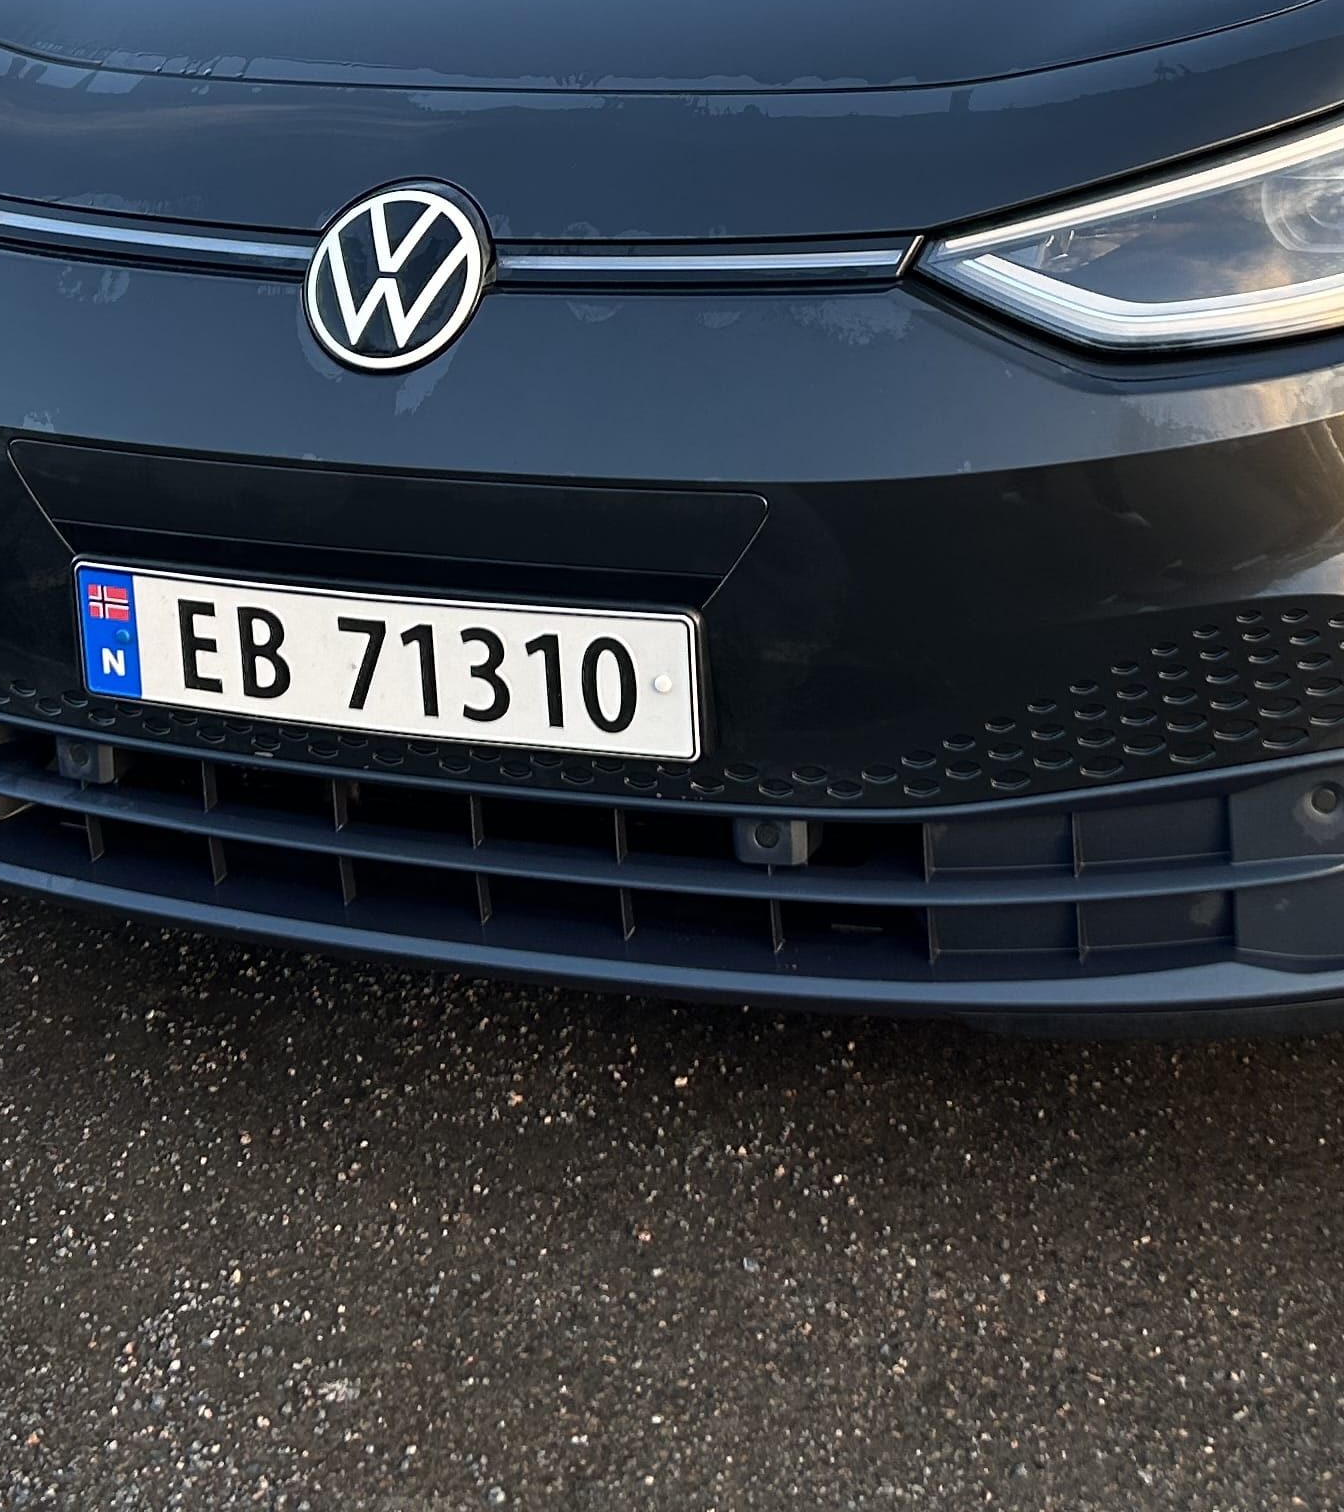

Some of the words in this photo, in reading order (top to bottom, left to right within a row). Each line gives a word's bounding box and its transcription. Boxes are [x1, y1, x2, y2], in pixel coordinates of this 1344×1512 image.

[316, 196, 474, 358] VW
[101, 647, 126, 677] N
[177, 598, 291, 699] EB
[337, 616, 638, 734] 71310
